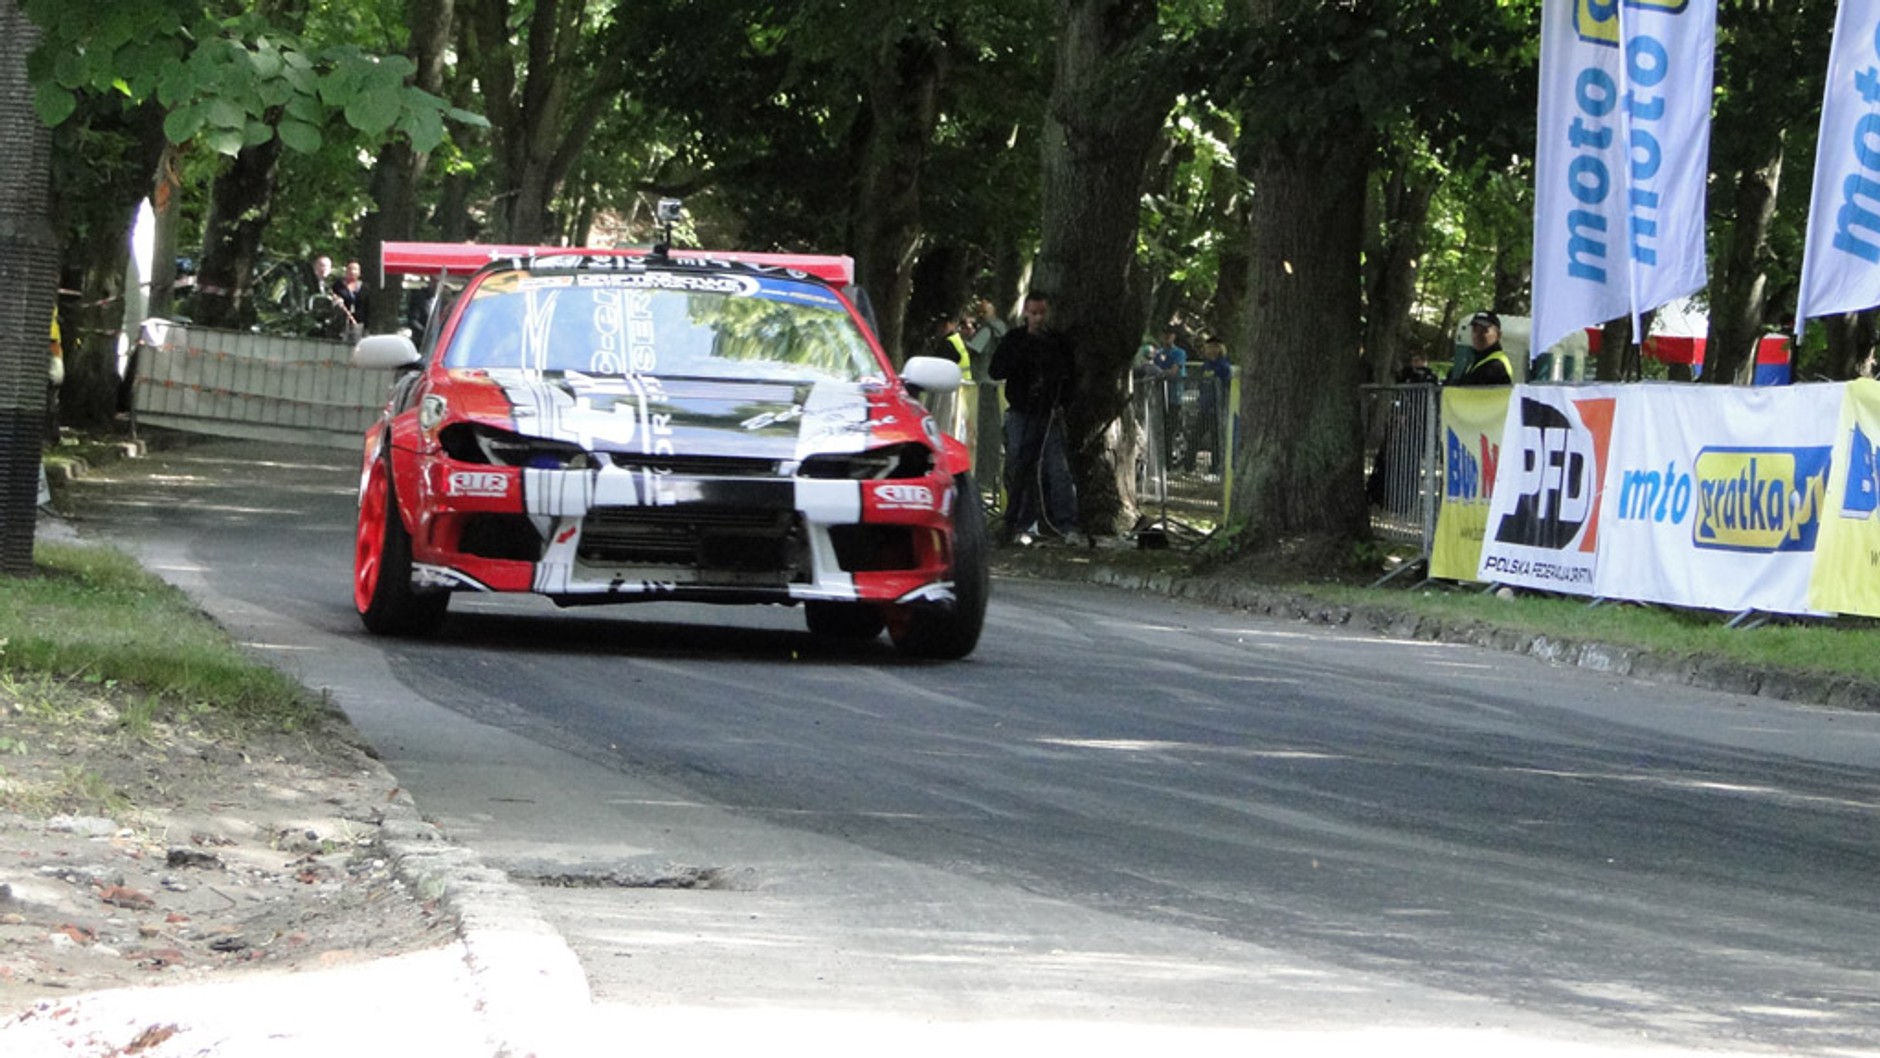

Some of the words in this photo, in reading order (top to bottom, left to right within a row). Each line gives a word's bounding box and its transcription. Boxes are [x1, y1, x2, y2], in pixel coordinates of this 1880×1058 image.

[1567, 67, 1617, 284] moto
[1507, 427, 1592, 524] PFD
[1484, 556, 1530, 575] POLSKA
